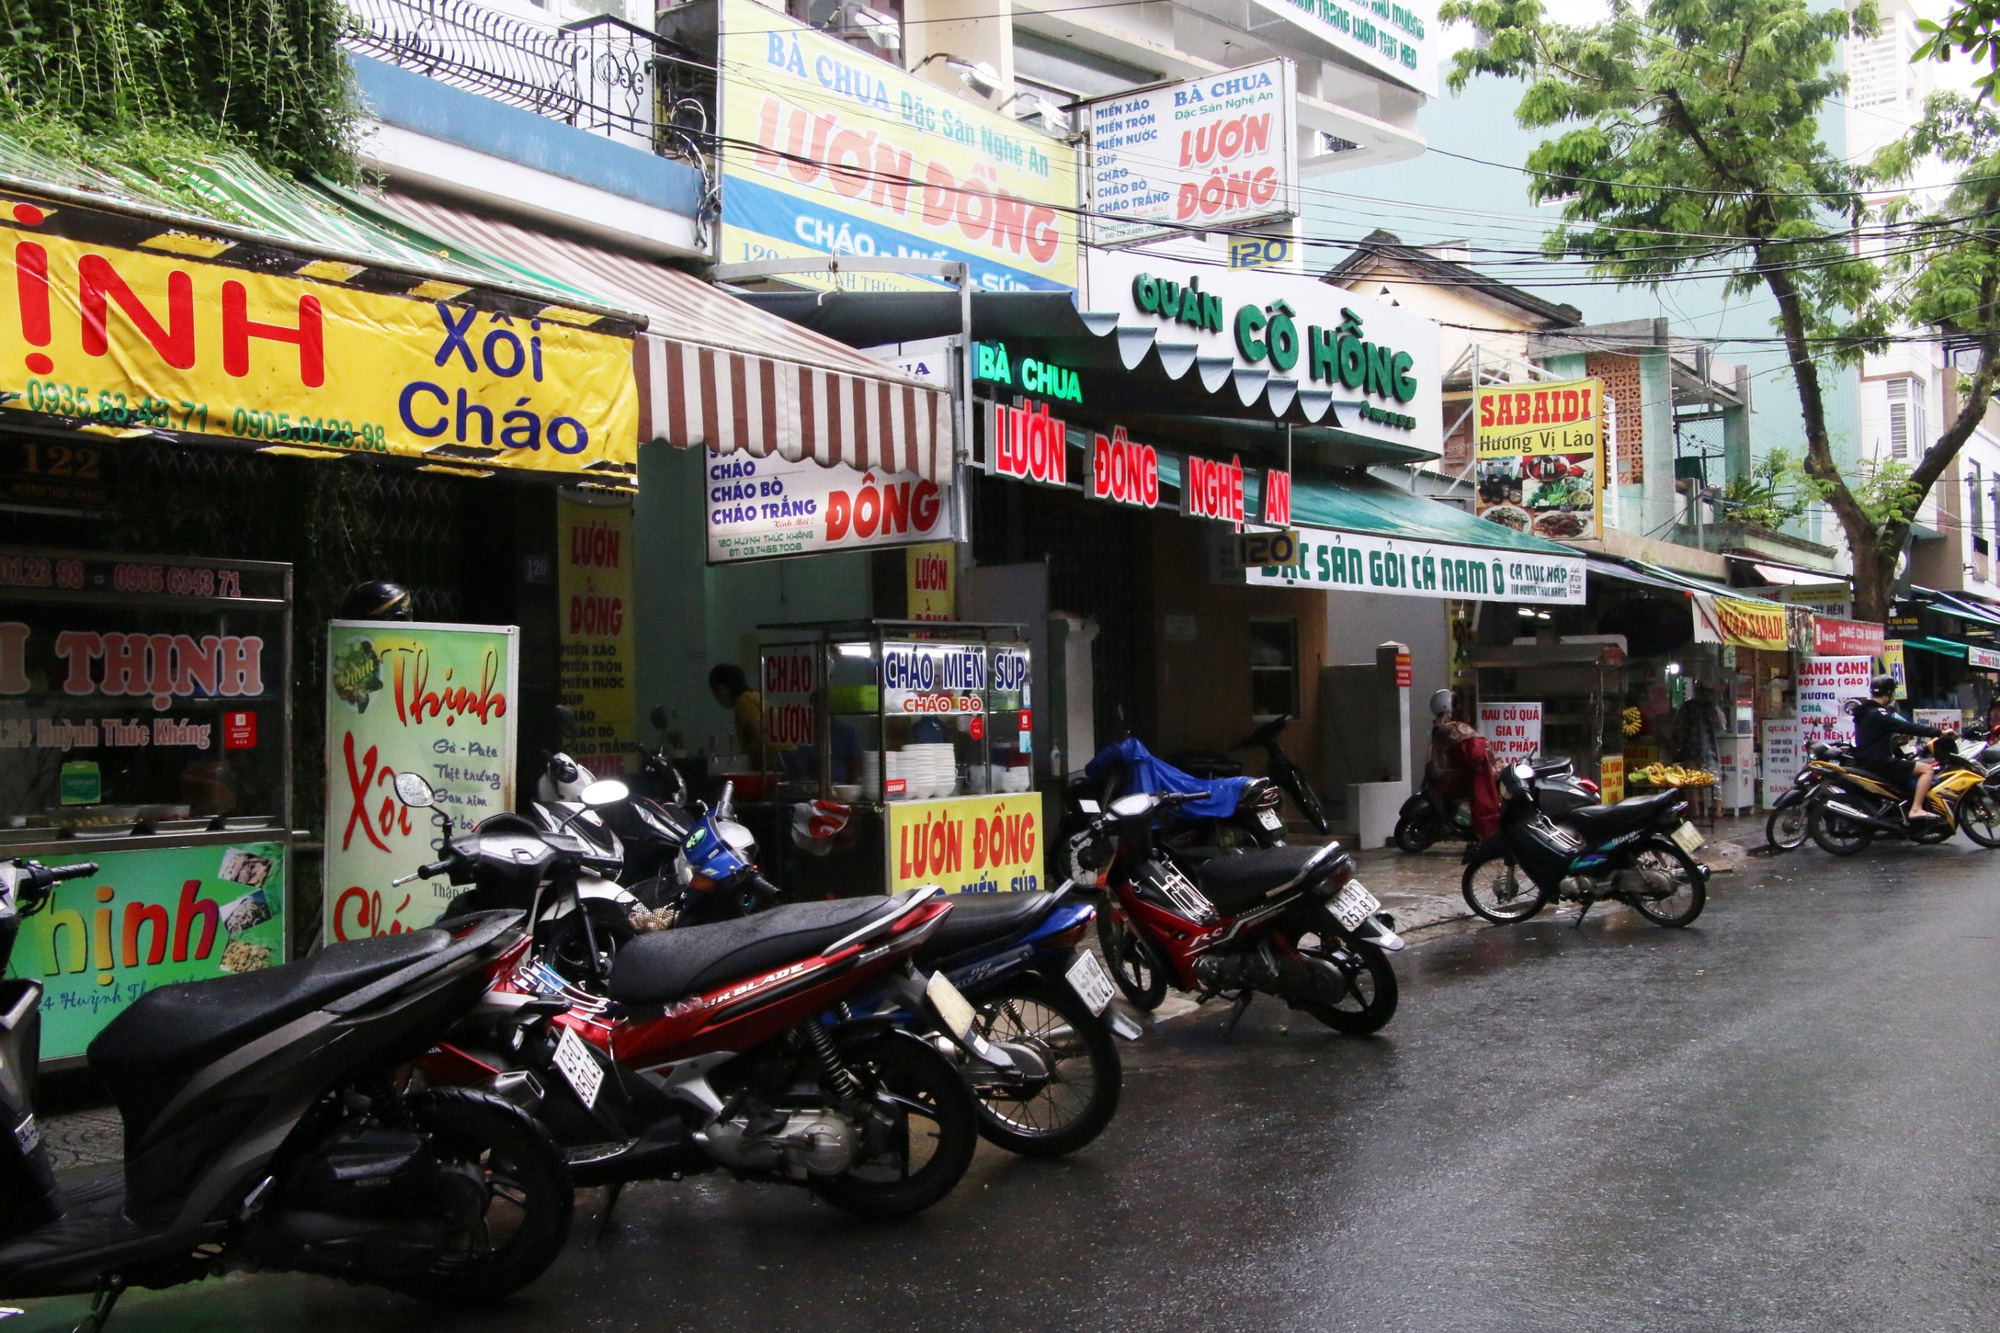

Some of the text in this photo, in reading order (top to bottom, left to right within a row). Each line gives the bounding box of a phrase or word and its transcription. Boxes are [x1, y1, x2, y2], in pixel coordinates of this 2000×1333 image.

[1399, 41, 1418, 70] HEO
[766, 28, 1050, 178] BÀ CHUA Đặc Sản Nghệ An
[1125, 98, 1150, 114] XÀO
[1174, 71, 1273, 107] BÀ CHUA
[1174, 90, 1274, 121] Đặc Sản Nghệ An
[1125, 113, 1156, 129] TRỘN
[1126, 128, 1158, 145] NƯỚC
[1178, 112, 1271, 168] LƯƠN
[1096, 152, 1117, 167] SÚP
[1097, 167, 1129, 182] CHÁO
[754, 95, 1060, 265] LƯƠN ĐỒNG
[1097, 178, 1148, 198] CHÁO BÒ
[1176, 164, 1279, 221] ĐỒNG
[1097, 191, 1170, 215] CHÁO TRẮNG
[795, 214, 875, 257] CHÁO
[1231, 238, 1288, 269] 120
[435, 303, 545, 383] Xôi
[1132, 272, 1418, 403] QUÁN CÔ HỒNG
[978, 343, 1083, 404] BÀ CHUA
[398, 381, 590, 454] Cháo
[1480, 388, 1591, 428] SABAIDI
[232, 406, 387, 452] 0905.0123.98
[1479, 429, 1594, 453] Hương Vị Lào
[23, 440, 100, 480] 122
[710, 458, 756, 480] CHÁO
[994, 398, 1291, 534] LƯƠN ĐỒNG NGHỆ AN
[710, 476, 784, 503] CHÁO BÒ
[711, 495, 817, 525] CHÁO TRẮNG
[571, 519, 621, 570] LƯƠN
[1239, 534, 1293, 565] 120
[56, 560, 85, 590] 98
[114, 563, 164, 593] 0935
[167, 567, 215, 597] 6343
[218, 570, 242, 598] 71
[914, 556, 947, 592] LƯƠN
[1316, 534, 1364, 585] SẢN
[1369, 540, 1407, 589] GỎI
[1411, 548, 1437, 591] CÁ
[1440, 557, 1488, 595] NAM
[1492, 557, 1505, 595] Ô
[1509, 560, 1523, 581] CÁ
[1525, 563, 1545, 585] NỤC
[1546, 564, 1568, 584] HẤP
[570, 576, 623, 638] ĐỒNG
[55, 630, 265, 711] THỊNH
[766, 647, 812, 693] CHÁO
[884, 644, 1026, 691] CHÁO MIẾN SÚP
[1835, 661, 1869, 675] CANH
[902, 692, 983, 713] CHÁO BÒ
[1481, 705, 1540, 721] RAU CỦ QUẢ
[36, 717, 99, 753] Huỳnh
[101, 716, 150, 748] Thúc
[153, 716, 211, 750] Kháng
[769, 703, 814, 746] LƯƠN
[1495, 725, 1526, 739] GIA VỊ
[899, 801, 1036, 881] LƯƠN ĐỒNG
[30, 879, 220, 986] hịnh
[733, 962, 805, 997] BLADE
